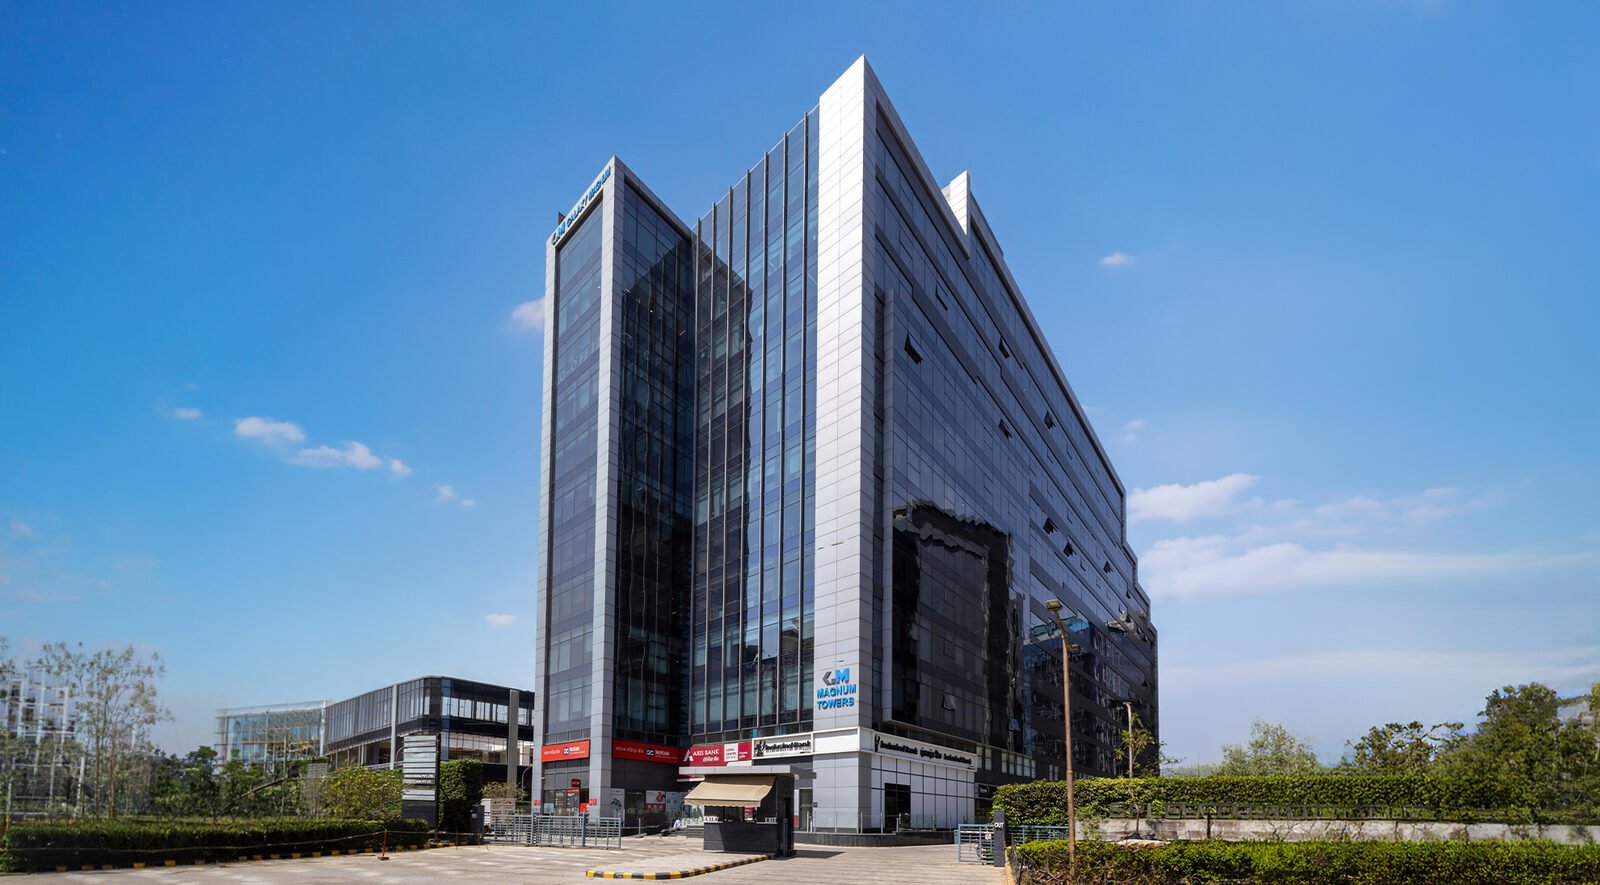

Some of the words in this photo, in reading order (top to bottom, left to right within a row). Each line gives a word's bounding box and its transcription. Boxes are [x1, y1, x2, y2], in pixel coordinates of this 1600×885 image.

[816, 684, 857, 699] MAGNUM
[816, 697, 855, 711] TOWERS
[705, 748, 720, 756] BANK
